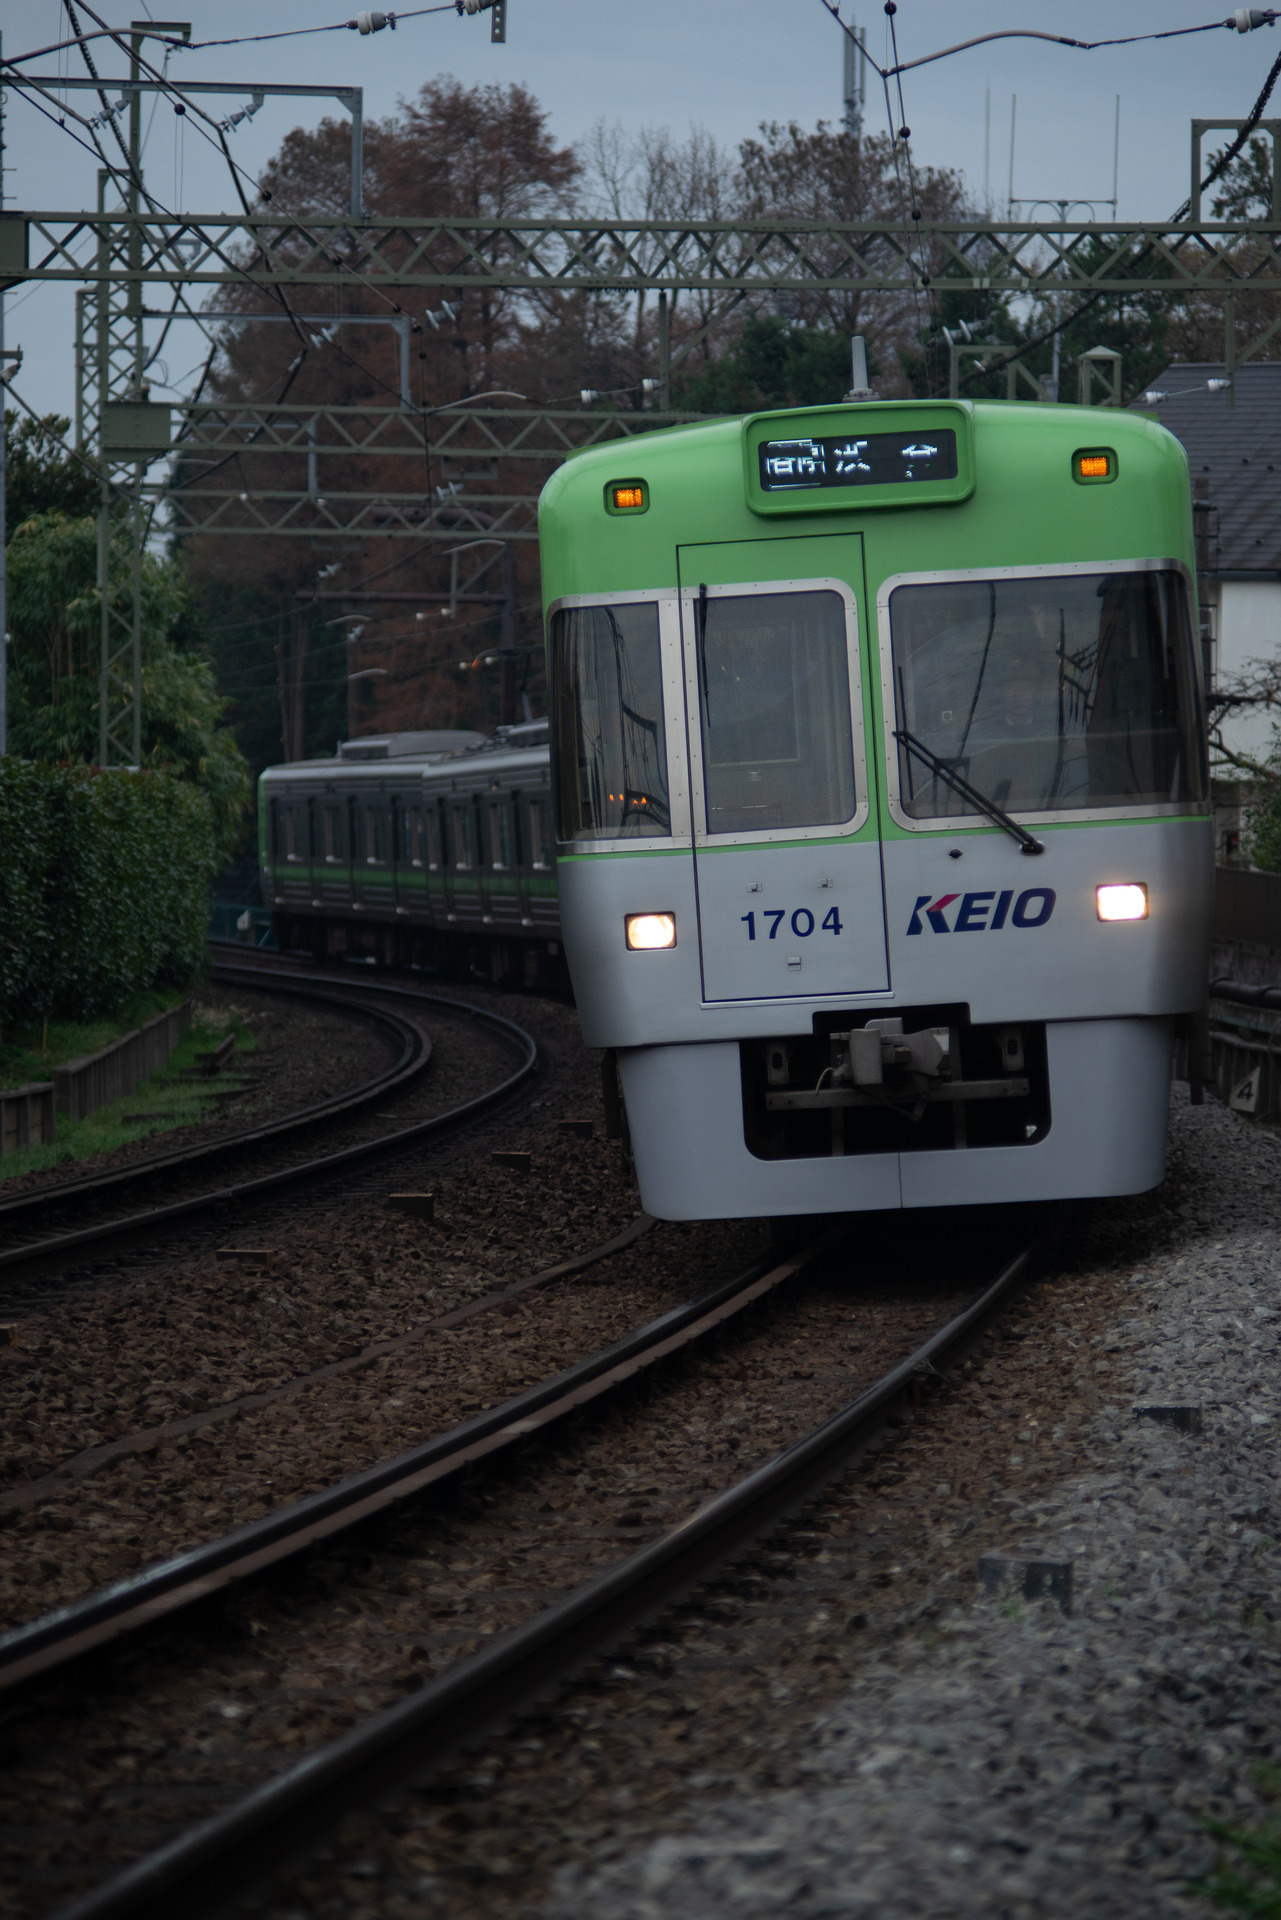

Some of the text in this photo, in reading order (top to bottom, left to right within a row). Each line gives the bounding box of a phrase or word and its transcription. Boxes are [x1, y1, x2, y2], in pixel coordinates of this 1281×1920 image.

[741, 906, 843, 940] 1704
[906, 888, 1056, 935] KEIO
[1237, 1081, 1254, 1100] 4
